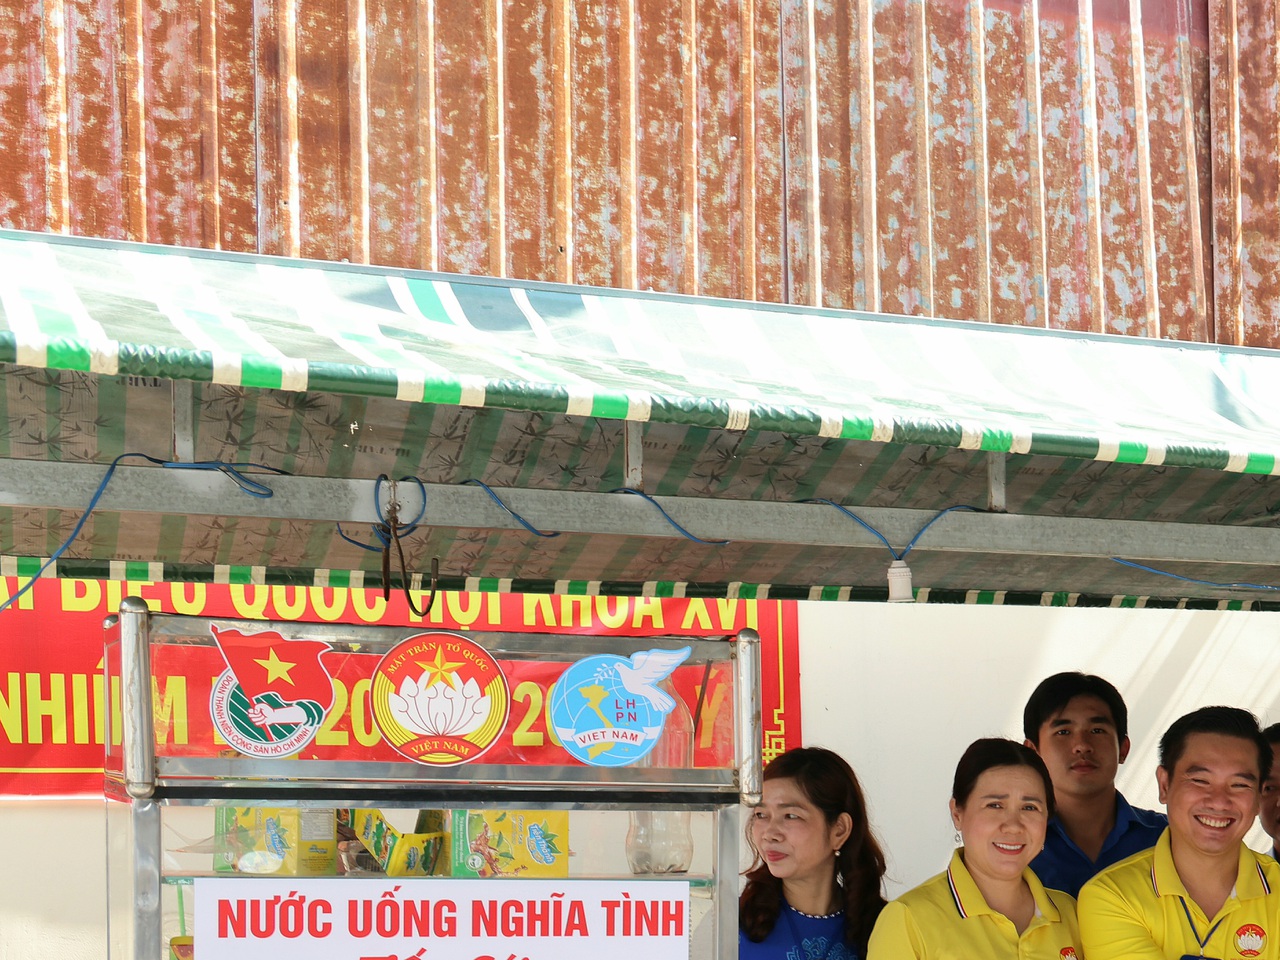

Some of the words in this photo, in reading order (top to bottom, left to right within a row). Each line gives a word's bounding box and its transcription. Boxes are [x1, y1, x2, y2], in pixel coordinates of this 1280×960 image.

[406, 642, 436, 656] TRẬN
[463, 650, 488, 672] QUỐC
[294, 728, 310, 745] MINH
[579, 731, 606, 744] VIET
[612, 731, 638, 742] NAM
[411, 740, 439, 754] VIỆT
[443, 741, 469, 755] NAM
[218, 891, 332, 939] NƯỚC
[347, 885, 457, 937] UỐNG
[472, 893, 589, 936] NGHĨA
[601, 892, 684, 936] TÌNH
